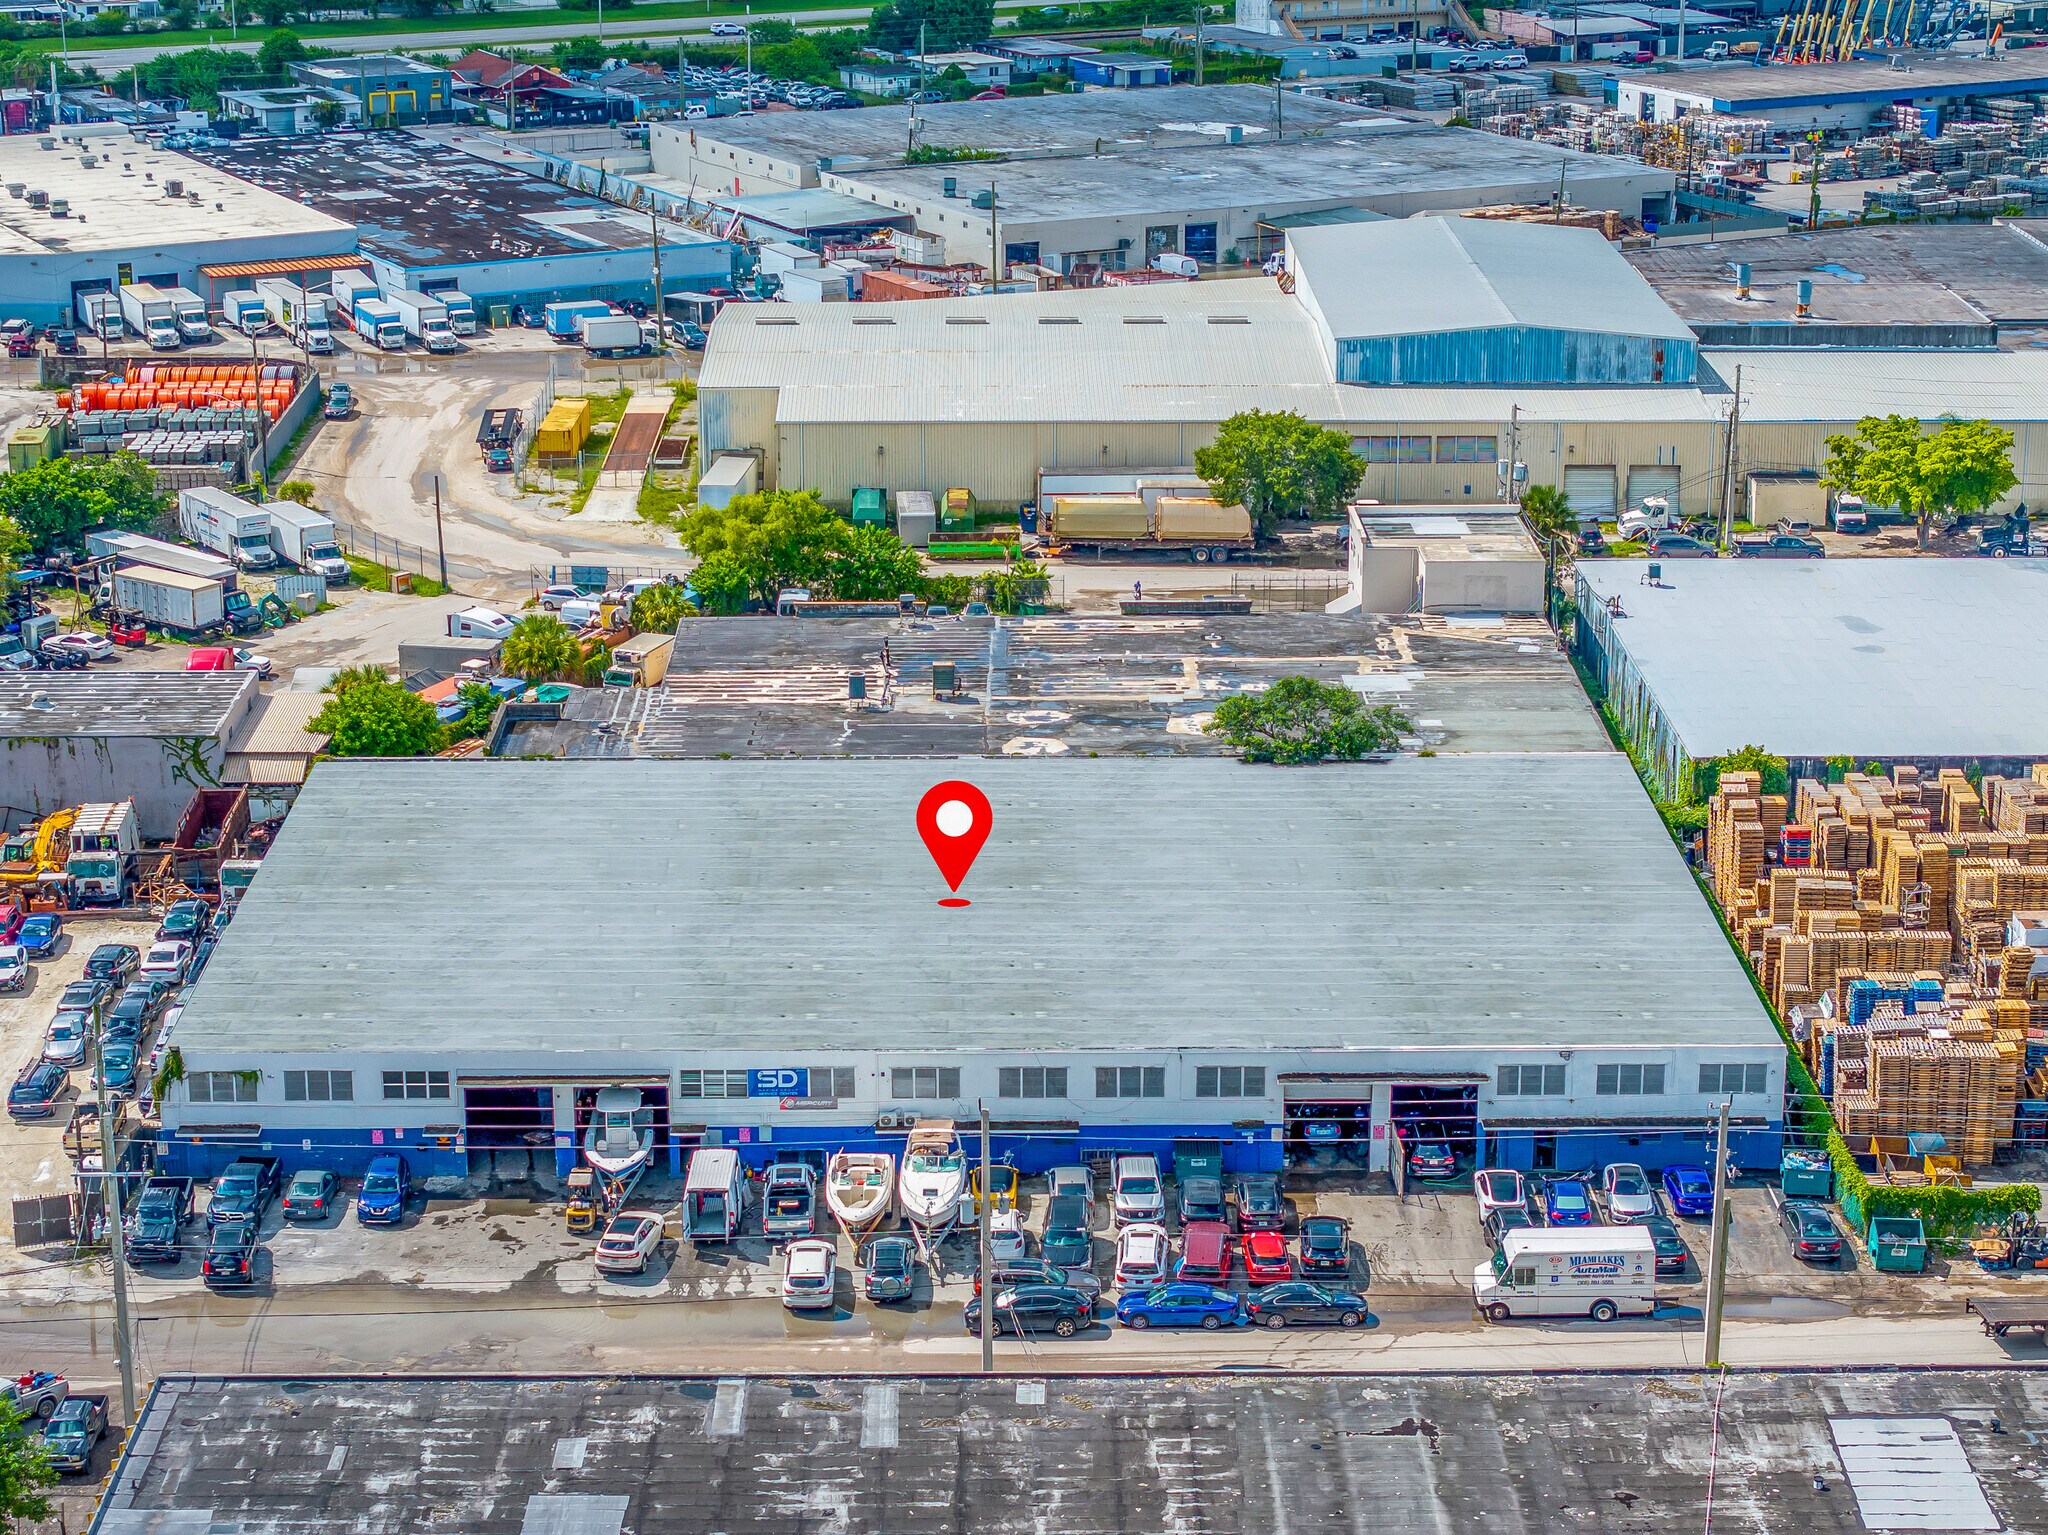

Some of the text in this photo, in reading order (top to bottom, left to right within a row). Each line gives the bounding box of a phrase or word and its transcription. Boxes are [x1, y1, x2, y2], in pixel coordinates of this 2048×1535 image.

[98, 863, 109, 876] R
[757, 1070, 798, 1088] SD
[1569, 1255, 1625, 1267] MIAMI LAKES
